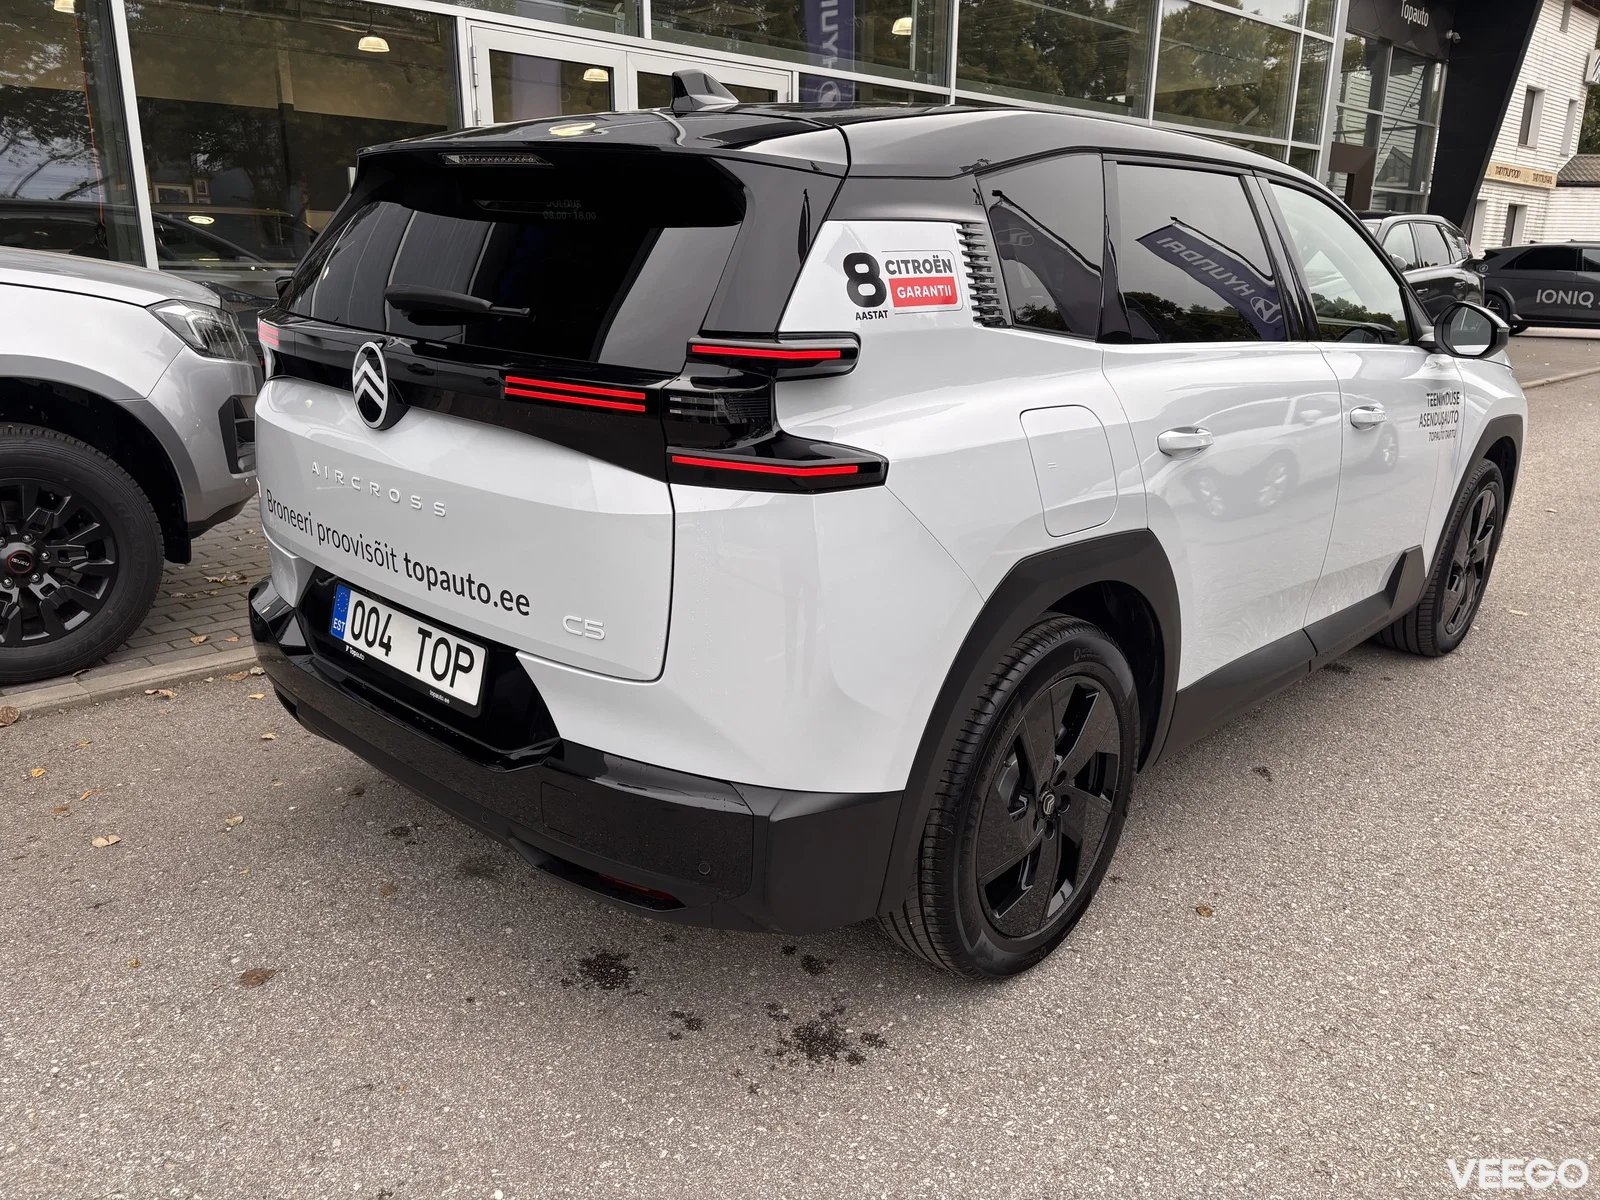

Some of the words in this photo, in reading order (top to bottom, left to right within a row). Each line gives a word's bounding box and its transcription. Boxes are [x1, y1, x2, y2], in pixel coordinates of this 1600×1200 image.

[1401, 0, 1429, 27] Topauto
[885, 254, 953, 275] CITROËN
[843, 252, 887, 308] 8
[897, 284, 952, 299] GARANTII
[1536, 288, 1594, 308] IONIQ
[855, 310, 889, 321] AASTAT
[1418, 410, 1459, 428] ASENDUSAUTO
[312, 461, 447, 517] AIRCROSS
[266, 489, 313, 536] Broneeri
[317, 522, 399, 573] proovisõit
[403, 552, 530, 617] topauto.ee
[333, 617, 346, 633] EST
[562, 614, 605, 640] C5
[350, 600, 392, 657] 004
[416, 627, 475, 688] TOP
